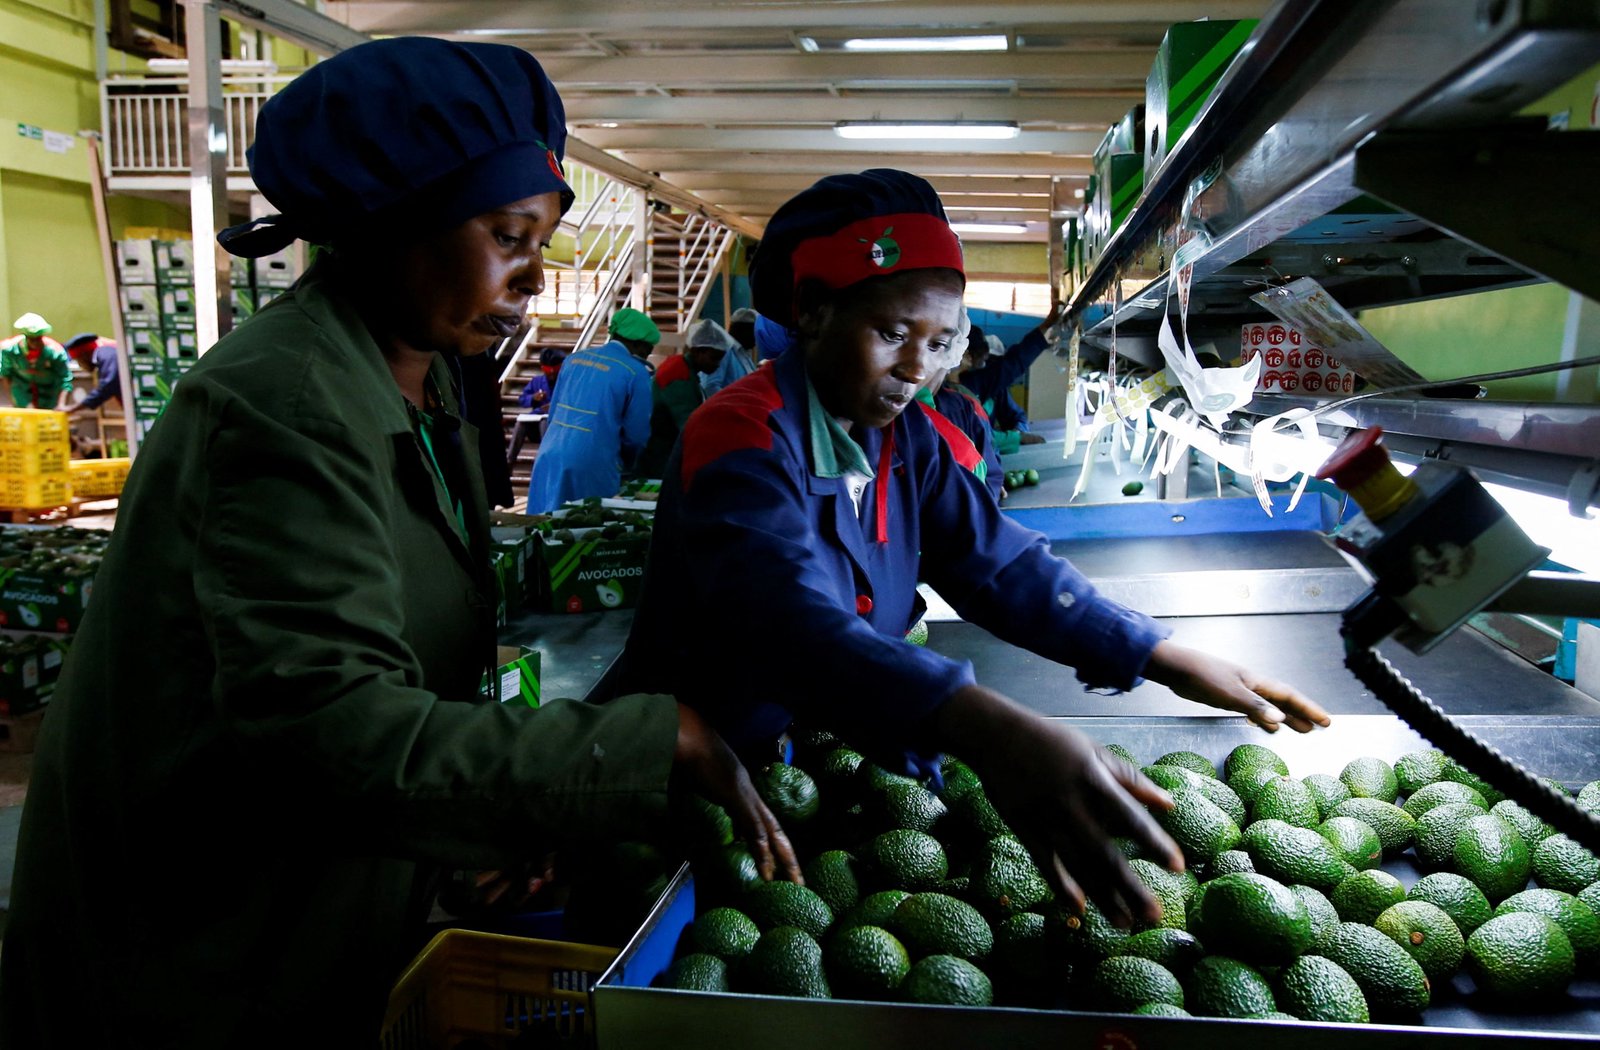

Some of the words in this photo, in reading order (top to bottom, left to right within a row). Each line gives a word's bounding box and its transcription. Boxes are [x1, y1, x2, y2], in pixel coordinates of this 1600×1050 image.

[1252, 334, 1262, 343] 16
[1270, 334, 1283, 343] 16
[1268, 357, 1281, 366] 16
[1308, 358, 1321, 366] 16
[1283, 380, 1297, 388] 16
[1306, 380, 1320, 389] 16
[1328, 381, 1338, 389] 16
[578, 567, 642, 580] AVOCADOS
[2, 591, 58, 604] AVOCADOS
